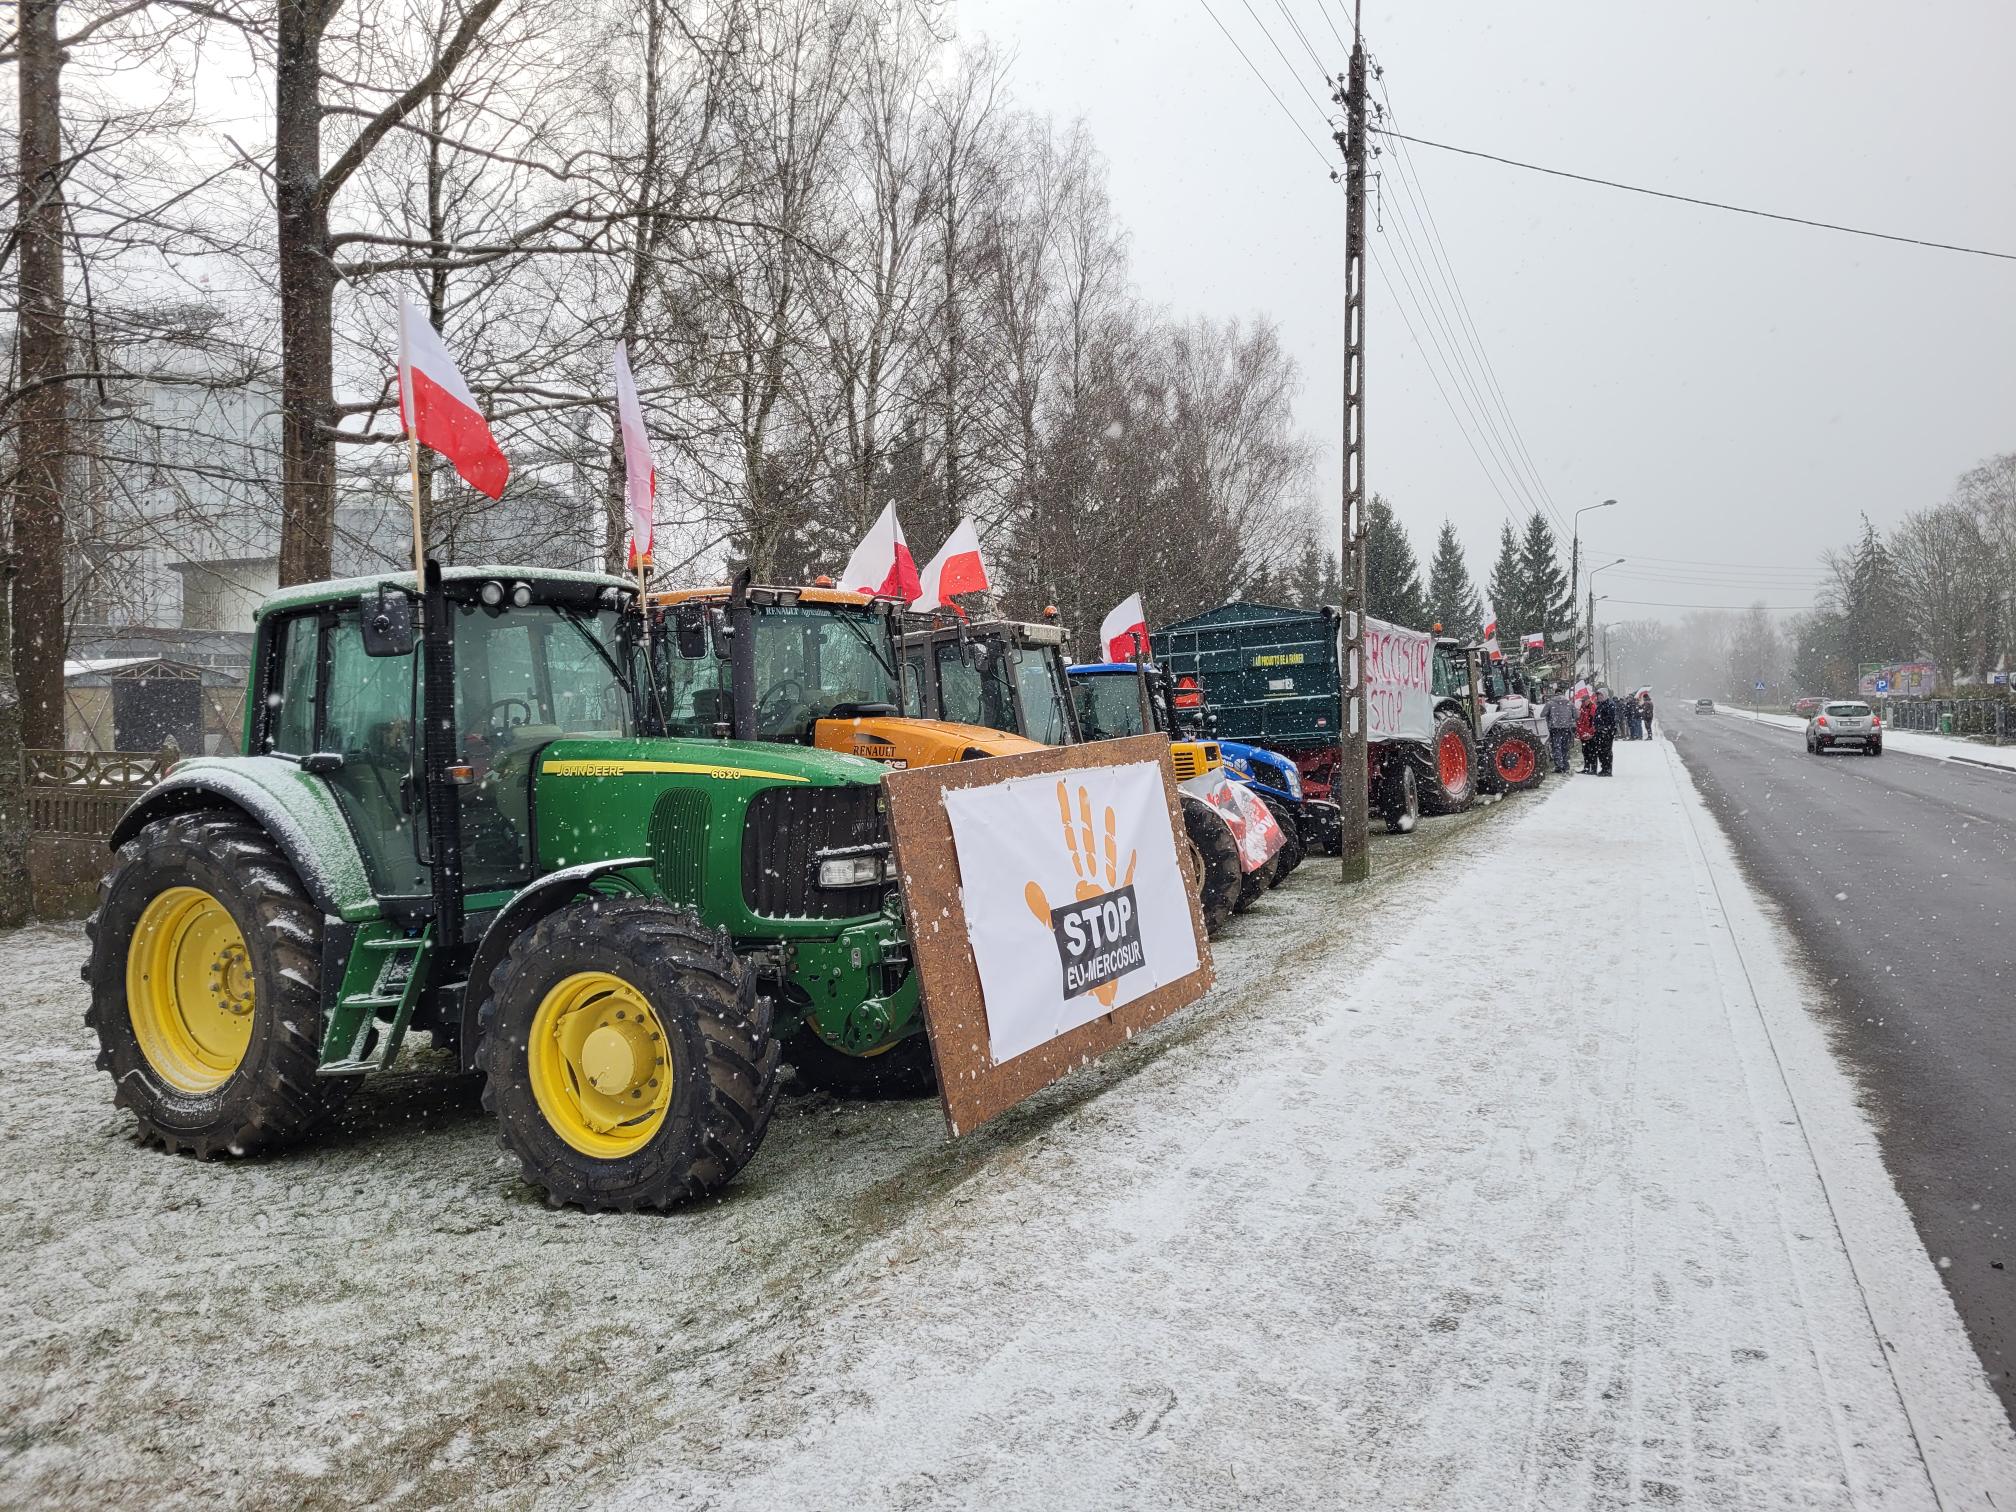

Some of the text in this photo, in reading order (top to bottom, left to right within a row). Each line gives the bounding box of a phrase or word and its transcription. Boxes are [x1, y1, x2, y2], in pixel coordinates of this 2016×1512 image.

[765, 606, 799, 616] RENAULT
[1878, 680, 1886, 689] P
[1371, 690, 1403, 732] STOP
[853, 745, 896, 757] RENAULT
[710, 769, 741, 780] 6620
[1063, 895, 1131, 956] STOP
[1067, 940, 1142, 991] EU-MERCOSUR
